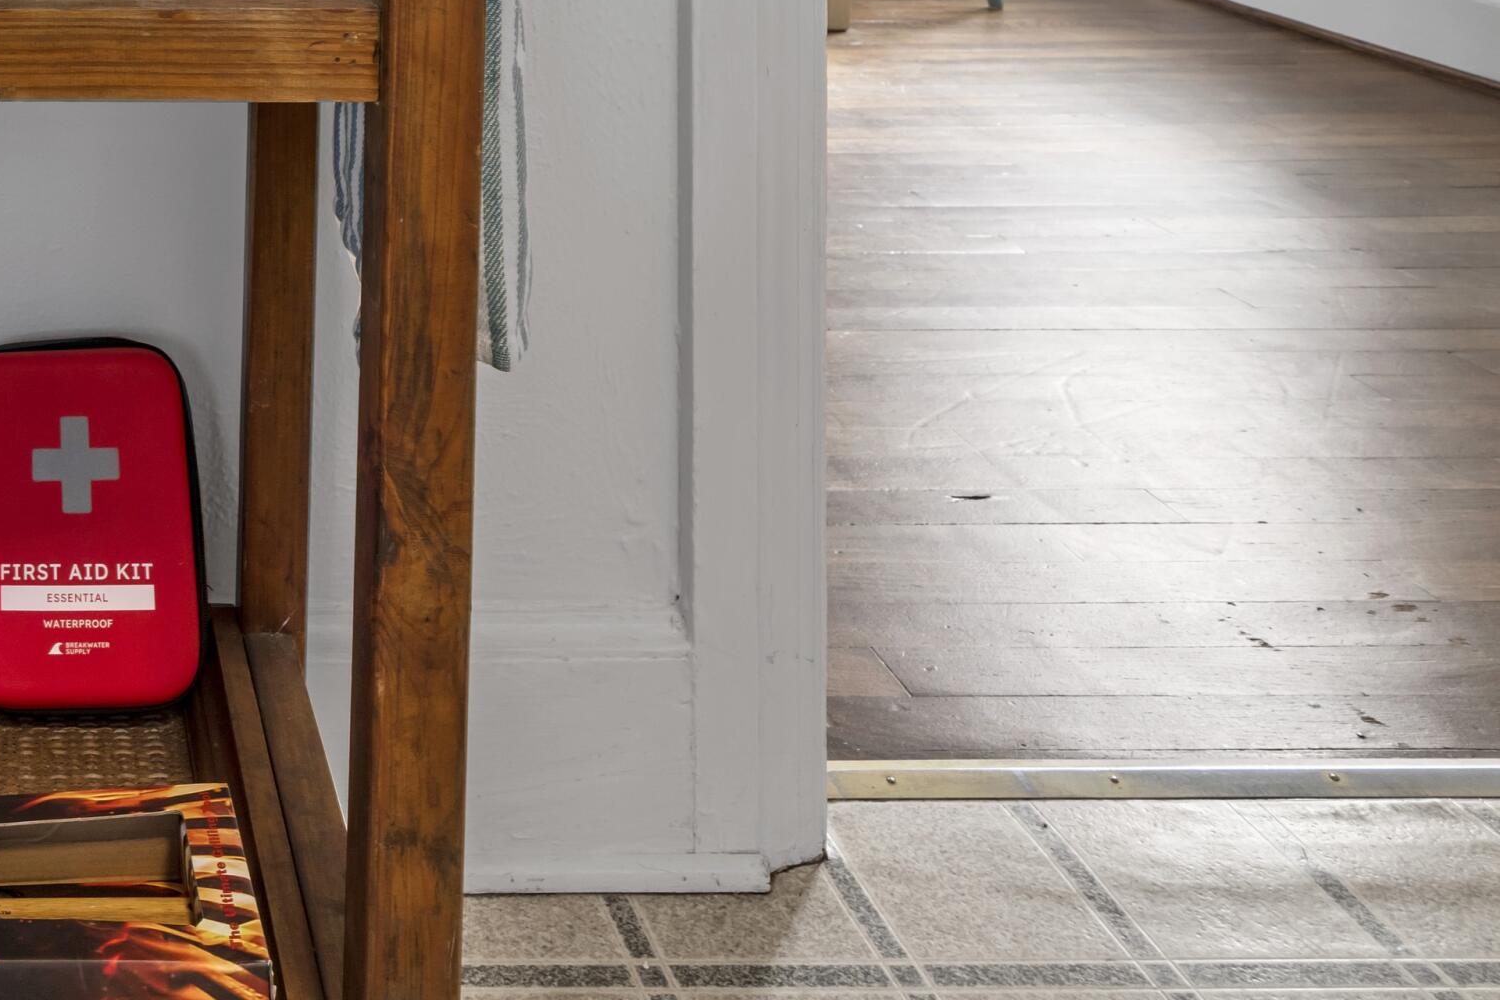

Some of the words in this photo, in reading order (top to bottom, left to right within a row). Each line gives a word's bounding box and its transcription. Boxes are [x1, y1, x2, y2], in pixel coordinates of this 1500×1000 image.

[0, 563, 61, 581] FIRST
[68, 563, 108, 581] AID
[116, 563, 153, 581] KIT
[46, 593, 108, 603] ESSENTIAL
[43, 619, 113, 629] WATERPROOF
[65, 641, 110, 649] BREAKWATER
[228, 921, 244, 950] The
